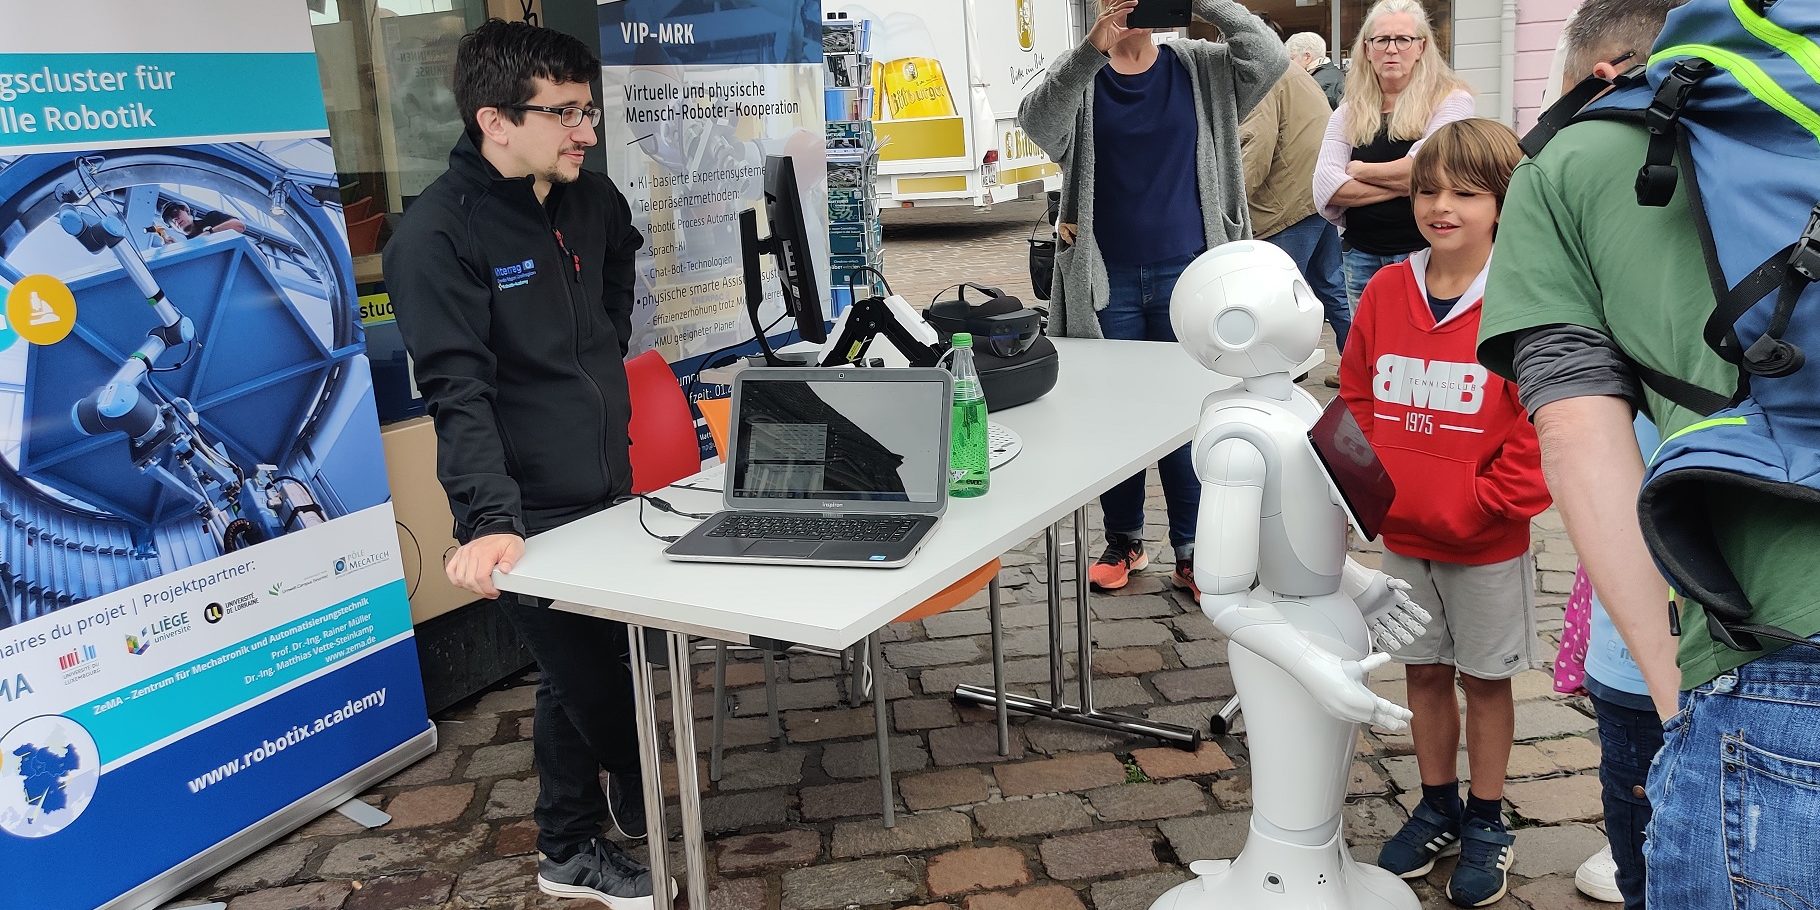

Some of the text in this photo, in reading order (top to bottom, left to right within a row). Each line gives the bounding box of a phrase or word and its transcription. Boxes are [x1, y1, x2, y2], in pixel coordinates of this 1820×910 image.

[620, 22, 695, 44] VIP-MRK
[0, 65, 176, 101] gscluster für
[624, 81, 765, 102] Virtuelle und physische
[0, 103, 157, 134] lle Robotik
[626, 100, 799, 124] Mensch-Roboter-Kooperation
[1015, 130, 1045, 160] Bitburg
[638, 165, 765, 190] KI-basierte Expertensysteme
[639, 191, 740, 212] Telepräsenzmethoden:
[647, 211, 739, 234] Robotic Process Automati
[648, 243, 686, 258] Sprach-KI
[650, 255, 733, 279] Chat-Bot-Technologien
[642, 286, 686, 308] physische
[689, 279, 720, 294] smarte
[652, 300, 717, 326] Effizienzerhöhung
[719, 298, 735, 311] trotz
[654, 321, 735, 348] KMU geeigneter Planer
[689, 388, 713, 405] fzeit:
[1373, 353, 1488, 415] BMB
[1408, 377, 1477, 391] TENNISCLUB
[1405, 411, 1434, 435] 1975
[51, 623, 73, 640] du
[77, 604, 127, 635] projet
[143, 561, 256, 608] Projektpartner:
[226, 598, 260, 615] DE LORRAINE
[151, 611, 190, 635] LIÈGE
[155, 625, 191, 643] université
[271, 613, 372, 660] Prof. Dr.-Ing. Rainer Müller
[325, 635, 376, 663] www.zema.de
[94, 696, 124, 716] ZeMA
[131, 675, 175, 699] Zentrum
[175, 668, 191, 681] für
[191, 645, 250, 675] Mechatronik
[251, 636, 268, 652] und
[269, 597, 370, 644] Automatisierungstechnik
[244, 625, 374, 685] Dr.-Ing. Matthias Vette-Steinkamp
[187, 687, 386, 794] www.robotix.academy
